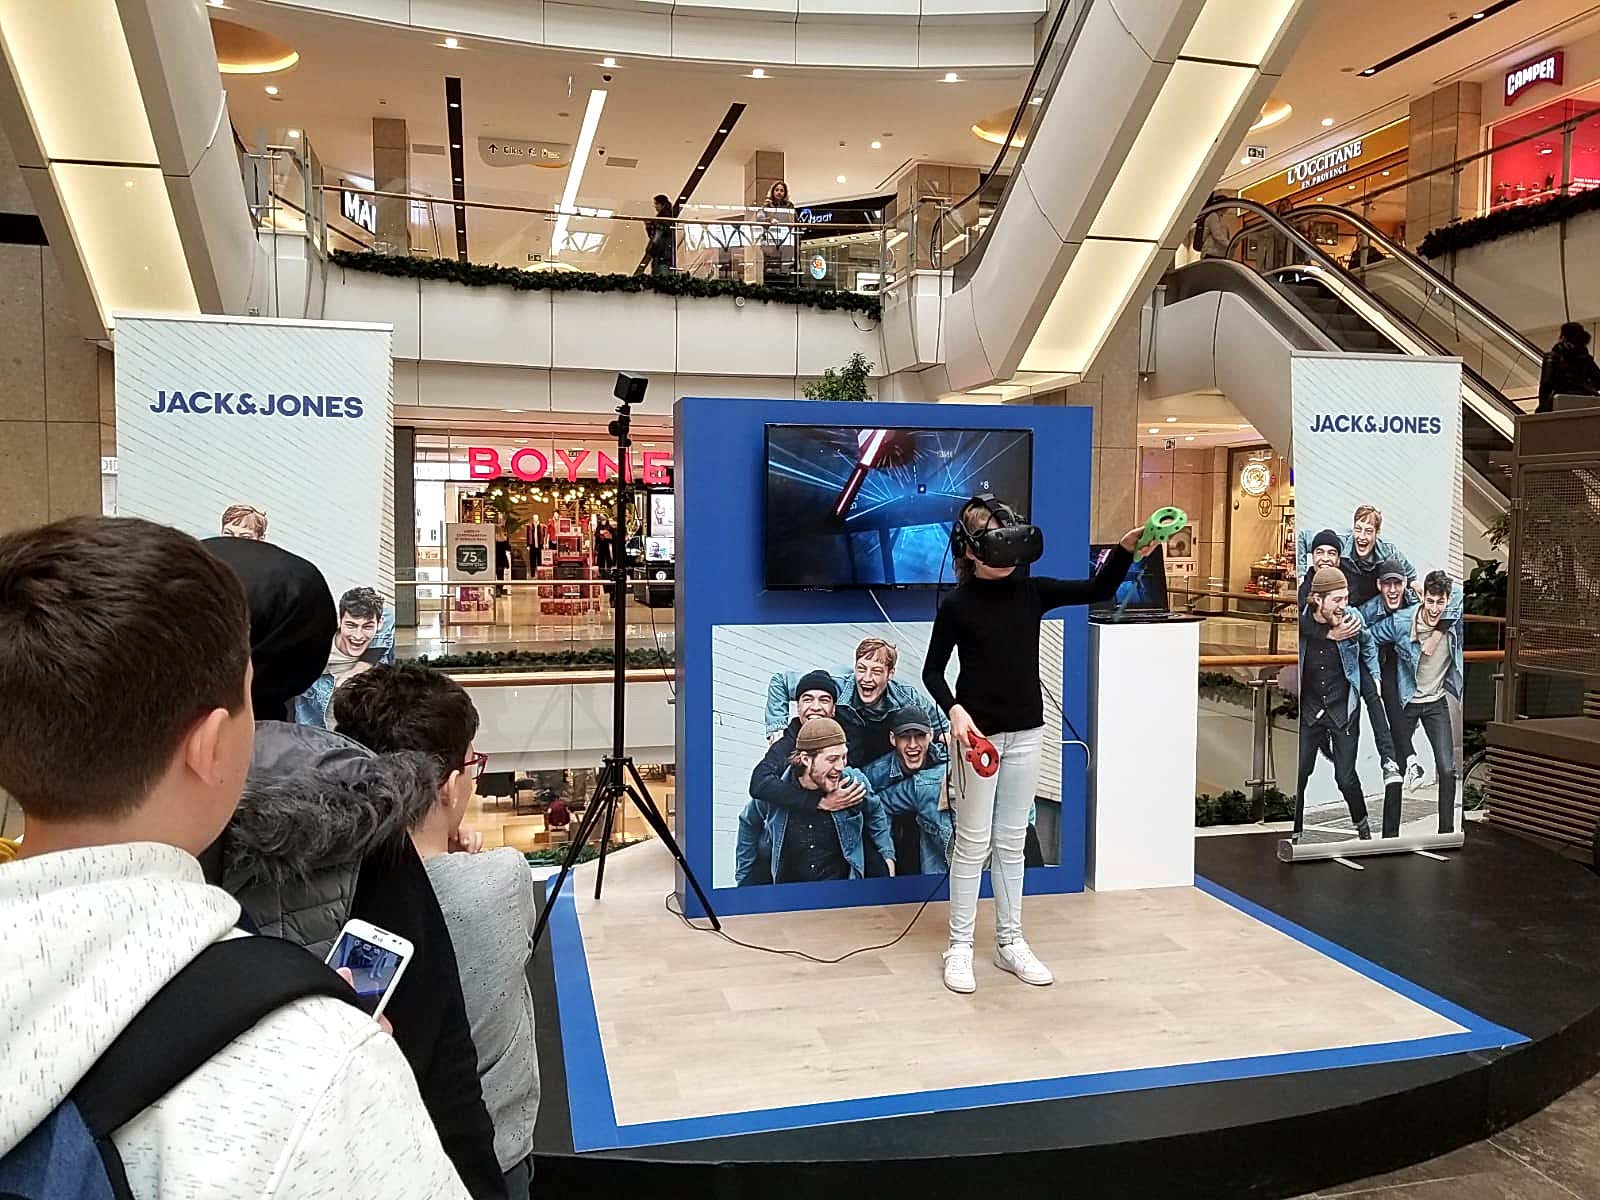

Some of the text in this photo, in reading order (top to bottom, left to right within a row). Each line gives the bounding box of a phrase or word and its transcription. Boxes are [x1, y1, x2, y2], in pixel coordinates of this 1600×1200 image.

[1507, 57, 1555, 96] CAMPER
[1287, 141, 1362, 185] L'OCCITANE
[150, 391, 364, 418] JACK&JONES
[1310, 415, 1441, 434] JACK&JONES
